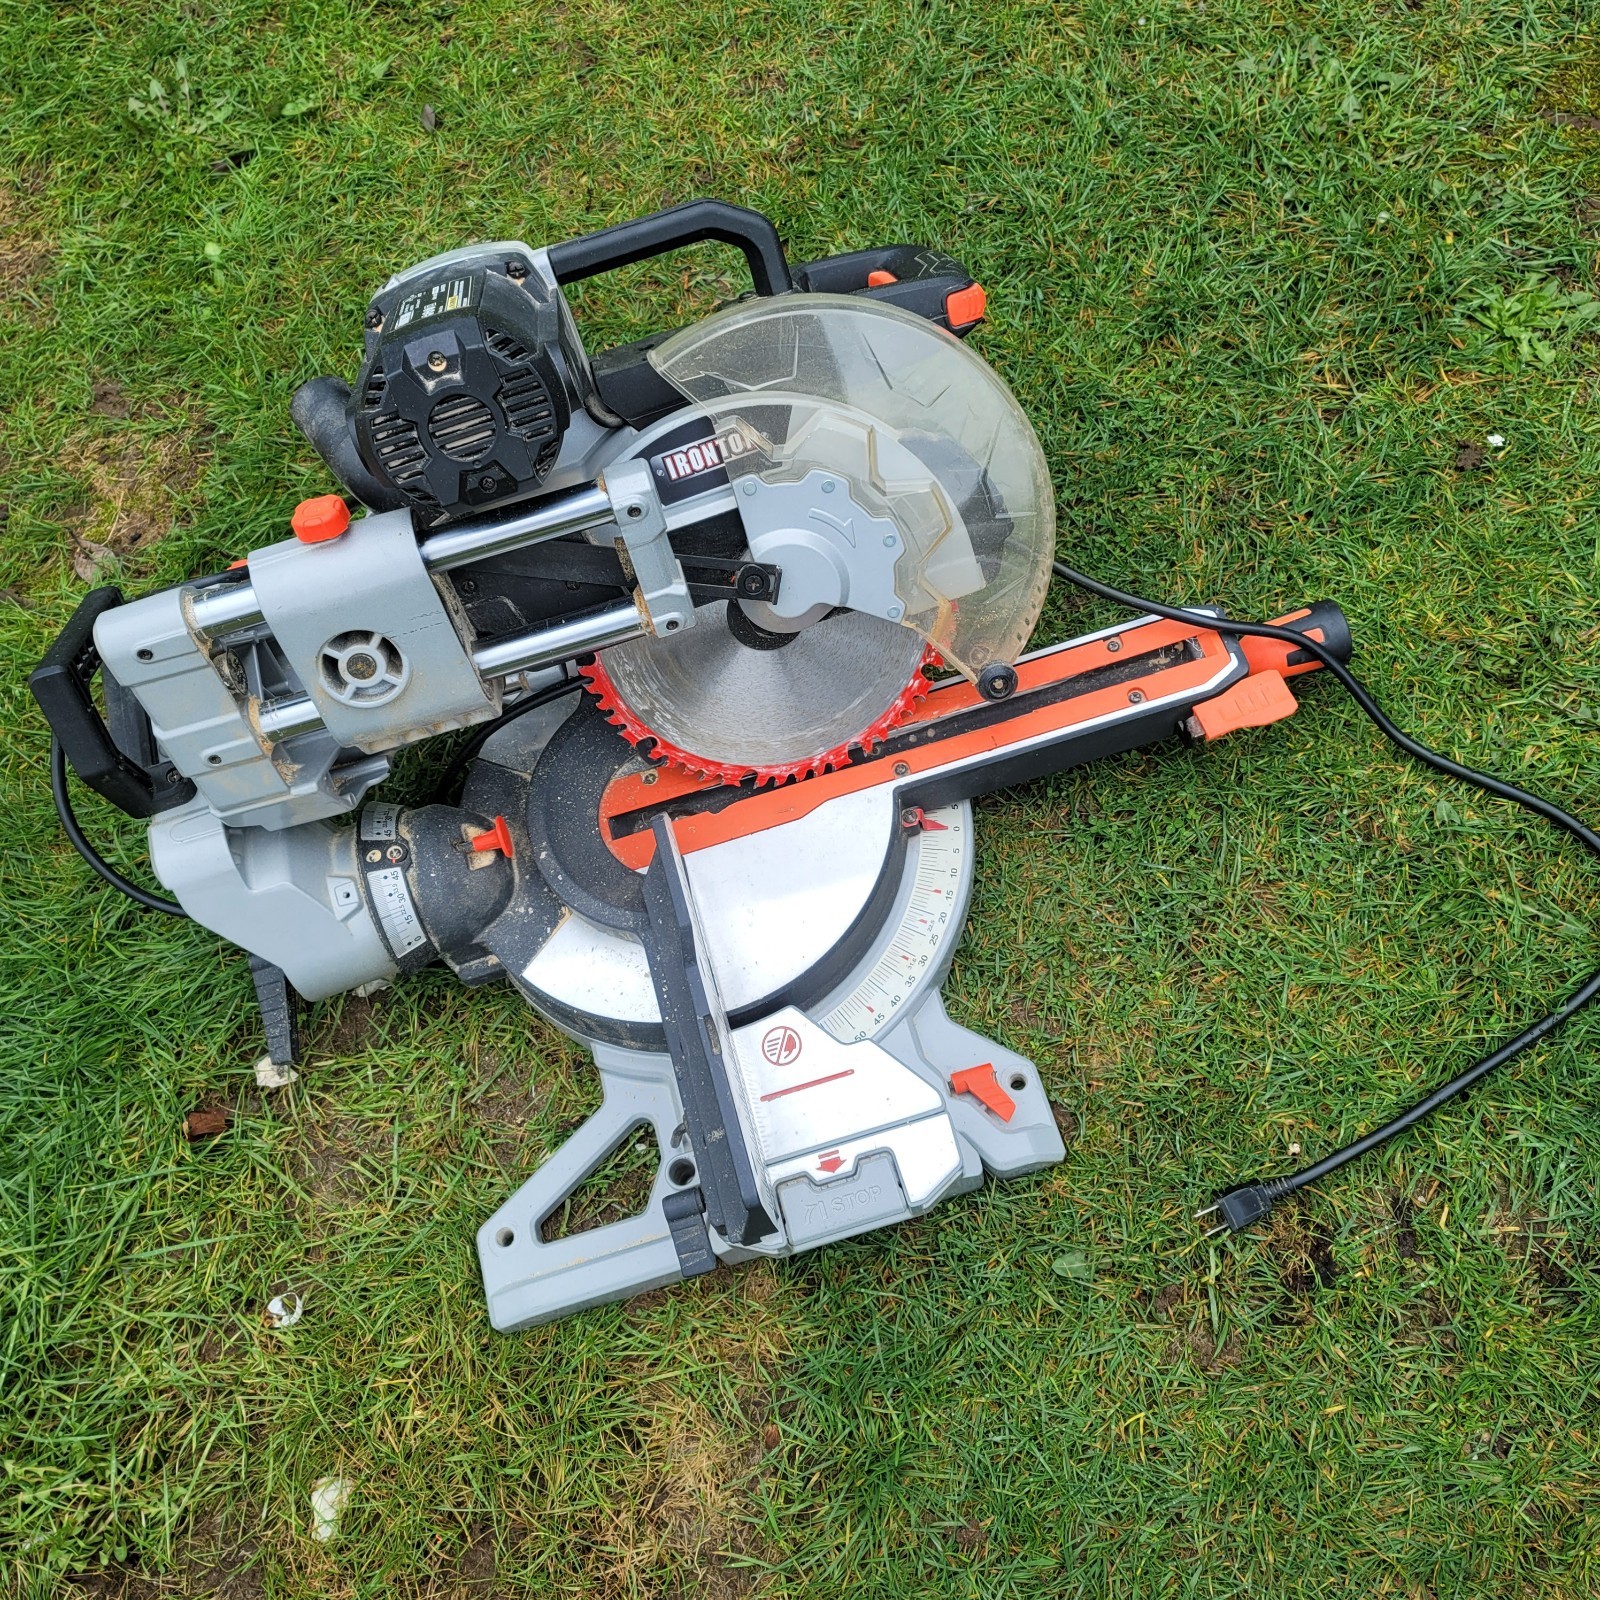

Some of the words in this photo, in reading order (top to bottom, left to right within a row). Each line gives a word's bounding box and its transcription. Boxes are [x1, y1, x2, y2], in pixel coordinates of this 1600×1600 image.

[384, 829, 392, 837] 45
[390, 870, 399, 881] 45
[950, 868, 958, 878] 10
[397, 893, 406, 904] 30
[945, 889, 954, 901] 15
[404, 914, 414, 924] 15
[938, 911, 948, 924] 20
[929, 933, 939, 946] 25
[918, 954, 928, 967] 30
[905, 974, 916, 988] 35
[890, 994, 902, 1008] 40
[874, 1012, 885, 1026] 45
[854, 1030, 867, 1041] 50
[832, 1186, 881, 1212] STOP
